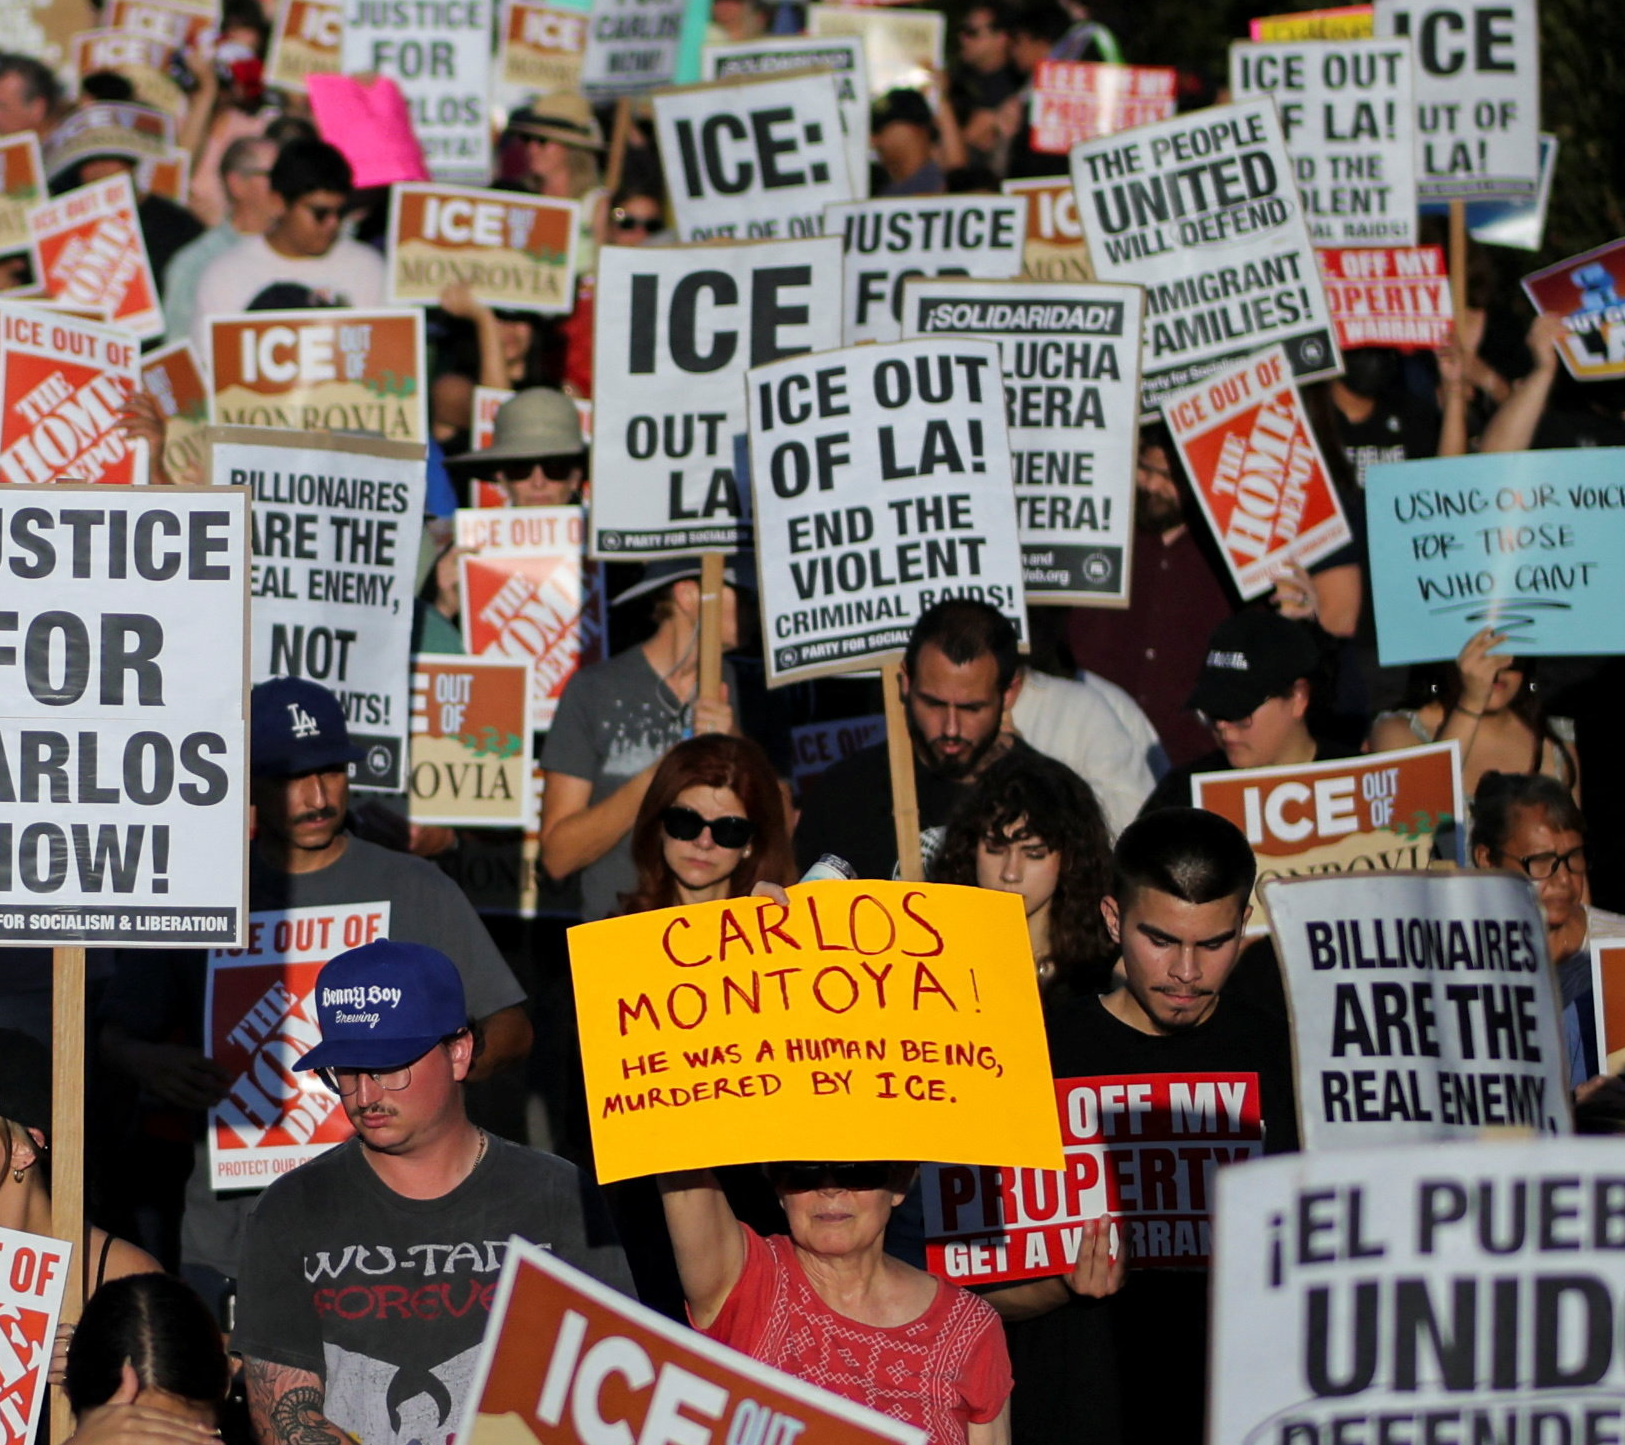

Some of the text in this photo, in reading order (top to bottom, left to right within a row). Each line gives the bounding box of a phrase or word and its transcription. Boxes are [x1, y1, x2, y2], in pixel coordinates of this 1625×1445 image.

[1239, 53, 1404, 91] ICE OUT
[1322, 102, 1397, 141] LA!
[676, 107, 832, 199] ICE:
[1083, 114, 1267, 184] THE PEOPLE
[1091, 150, 1279, 236] UNITED
[423, 199, 502, 243] ICE
[1105, 198, 1287, 266] WILL DEFEND
[925, 303, 1115, 332] ¡SOLIDARIDAD!
[240, 326, 334, 382] ICE
[759, 355, 989, 431] ICE OUT
[770, 417, 986, 500] OF LA!
[787, 493, 974, 556] END THE
[1394, 491, 1488, 522] USING
[1496, 486, 1560, 511] OUR
[790, 537, 987, 600] VIOLENT
[1412, 524, 1574, 561] FOR THOSE
[1417, 561, 1599, 602] WHO CANT
[775, 599, 911, 640] CRIMINAL
[287, 703, 321, 738] LA
[29, 913, 113, 930] SOCIALISM
[118, 914, 131, 930] &
[136, 914, 228, 932] LIBERATION
[662, 891, 943, 969] CARLOS
[1307, 917, 1539, 975] BILLIONAIRES
[336, 1010, 380, 1028] Brewing
[1330, 980, 1542, 1062] ARE THE
[622, 1035, 1003, 1078] HE WAS A HUMAN BEING,
[602, 1071, 957, 1116] MURDERED BY ICE.
[1321, 1069, 1431, 1123] REAL
[1268, 1183, 1386, 1288] ¡EL
